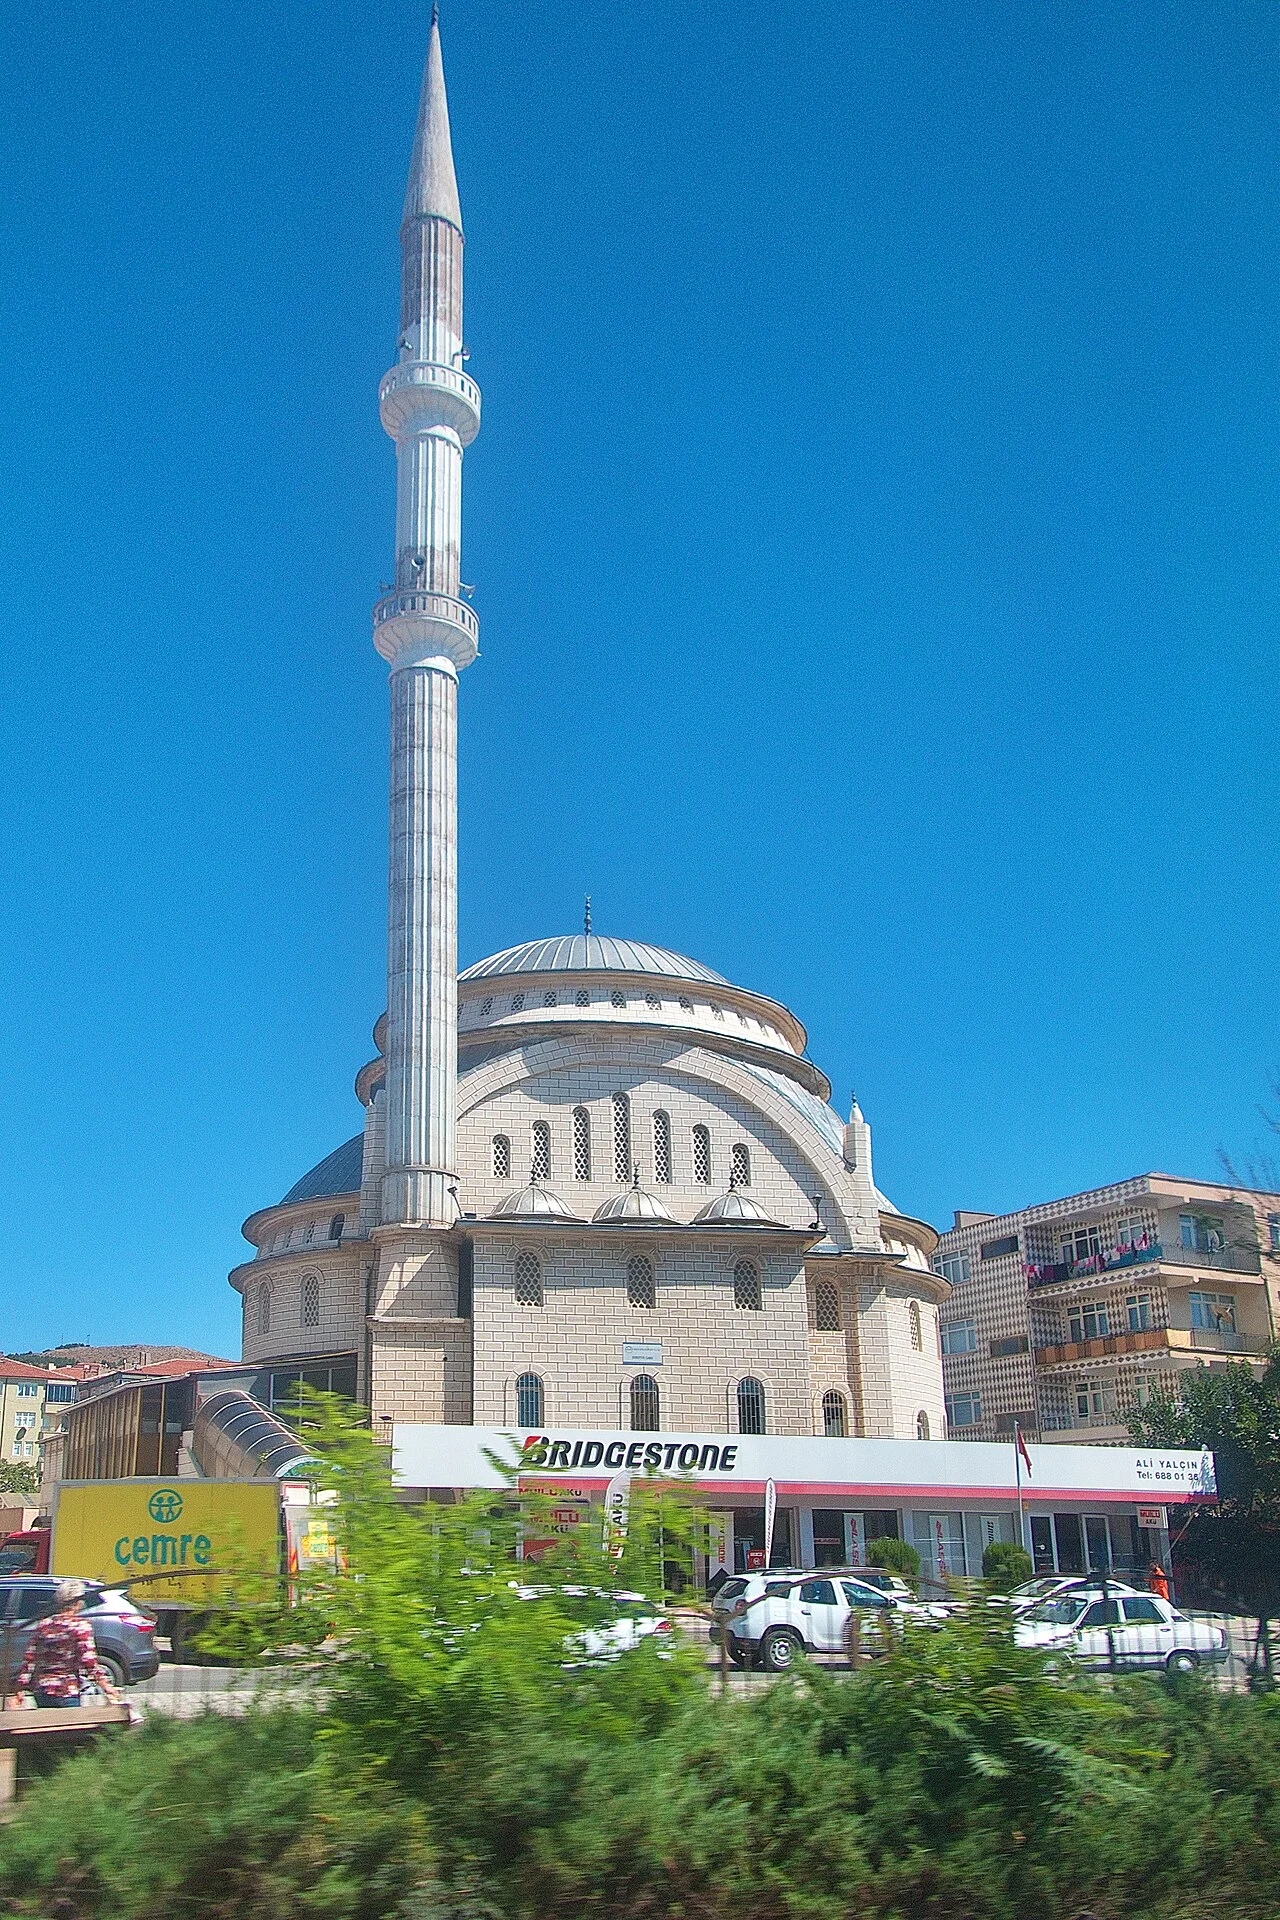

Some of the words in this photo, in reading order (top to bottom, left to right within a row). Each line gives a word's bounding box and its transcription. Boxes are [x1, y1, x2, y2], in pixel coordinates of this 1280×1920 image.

[519, 1436, 738, 1471] BRIDGESTONE
[1137, 1471, 1153, 1479] Tel:
[114, 1534, 211, 1566] cemre
